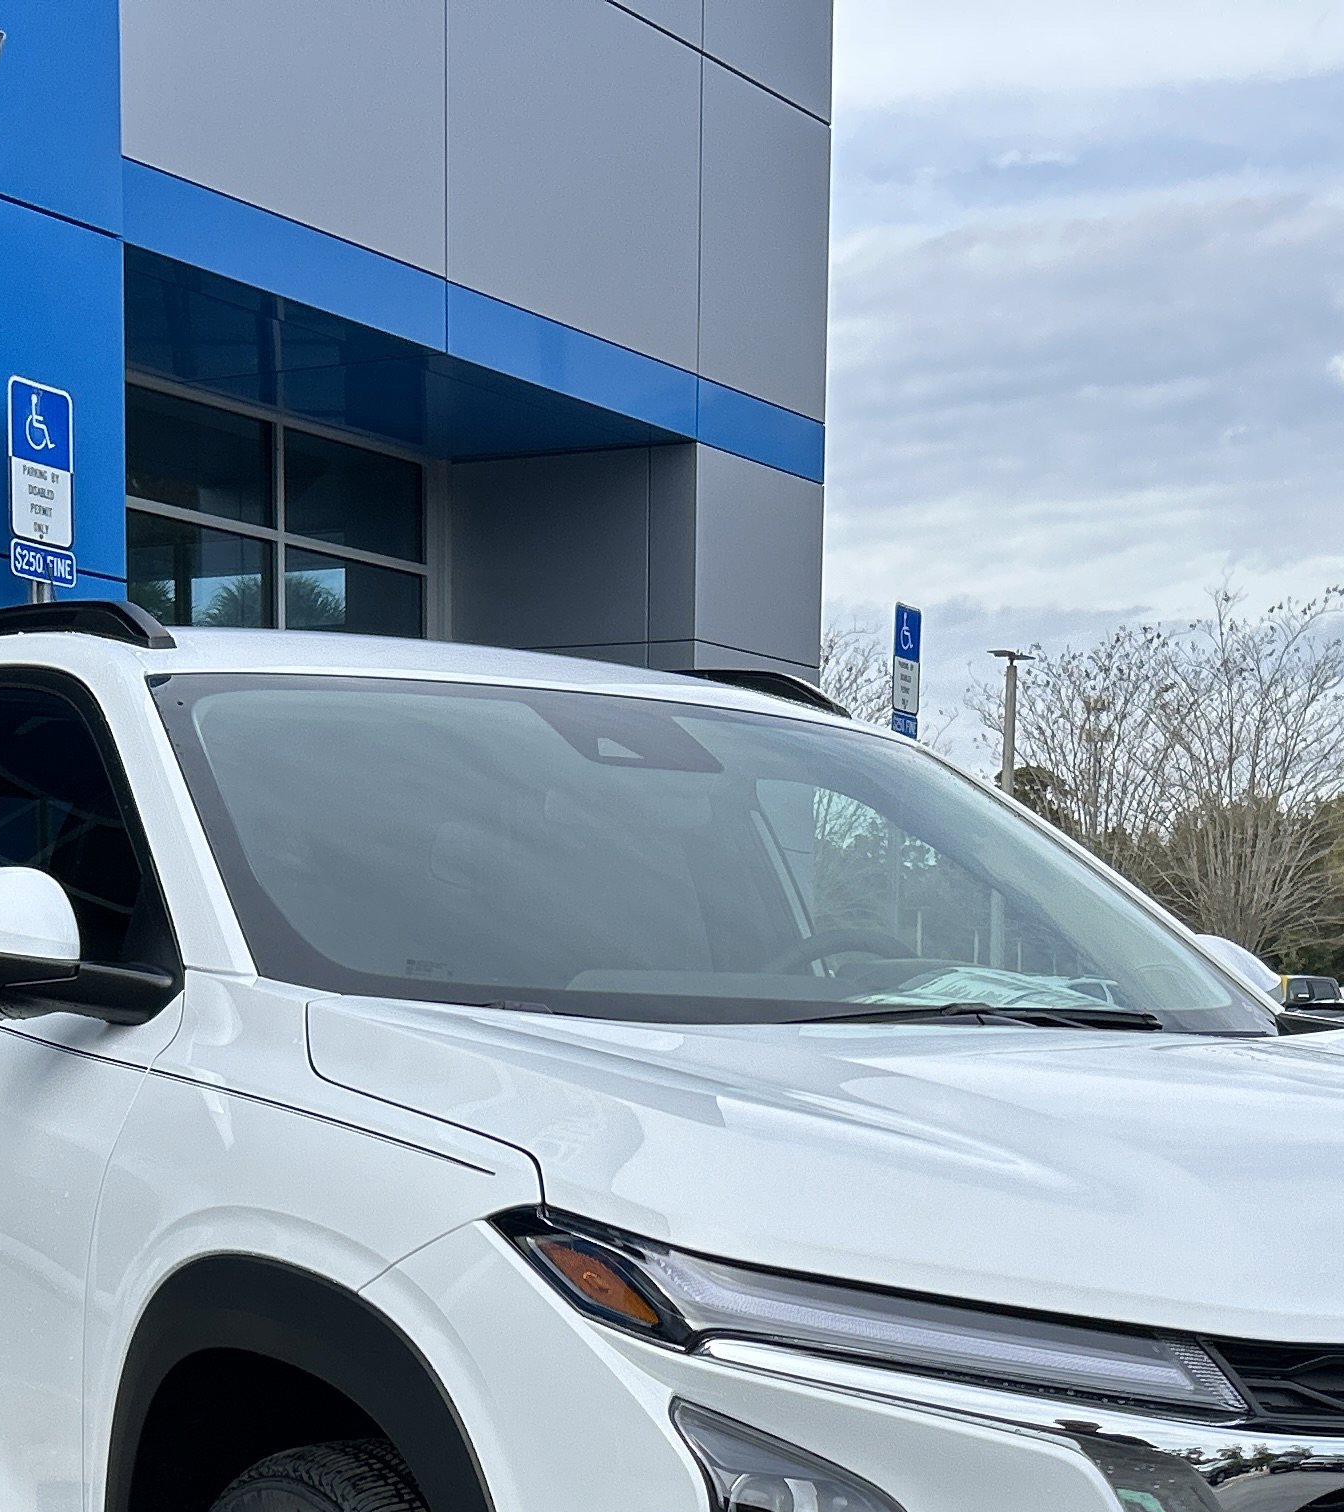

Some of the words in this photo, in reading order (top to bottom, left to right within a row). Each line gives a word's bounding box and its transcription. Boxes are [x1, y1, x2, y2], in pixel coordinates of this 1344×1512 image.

[23, 464, 47, 480] PARKING
[28, 484, 54, 500] DISABLED
[30, 503, 52, 517] PERMIT
[33, 522, 49, 534] ONLY
[16, 546, 43, 574] $250
[47, 556, 72, 580] FINE
